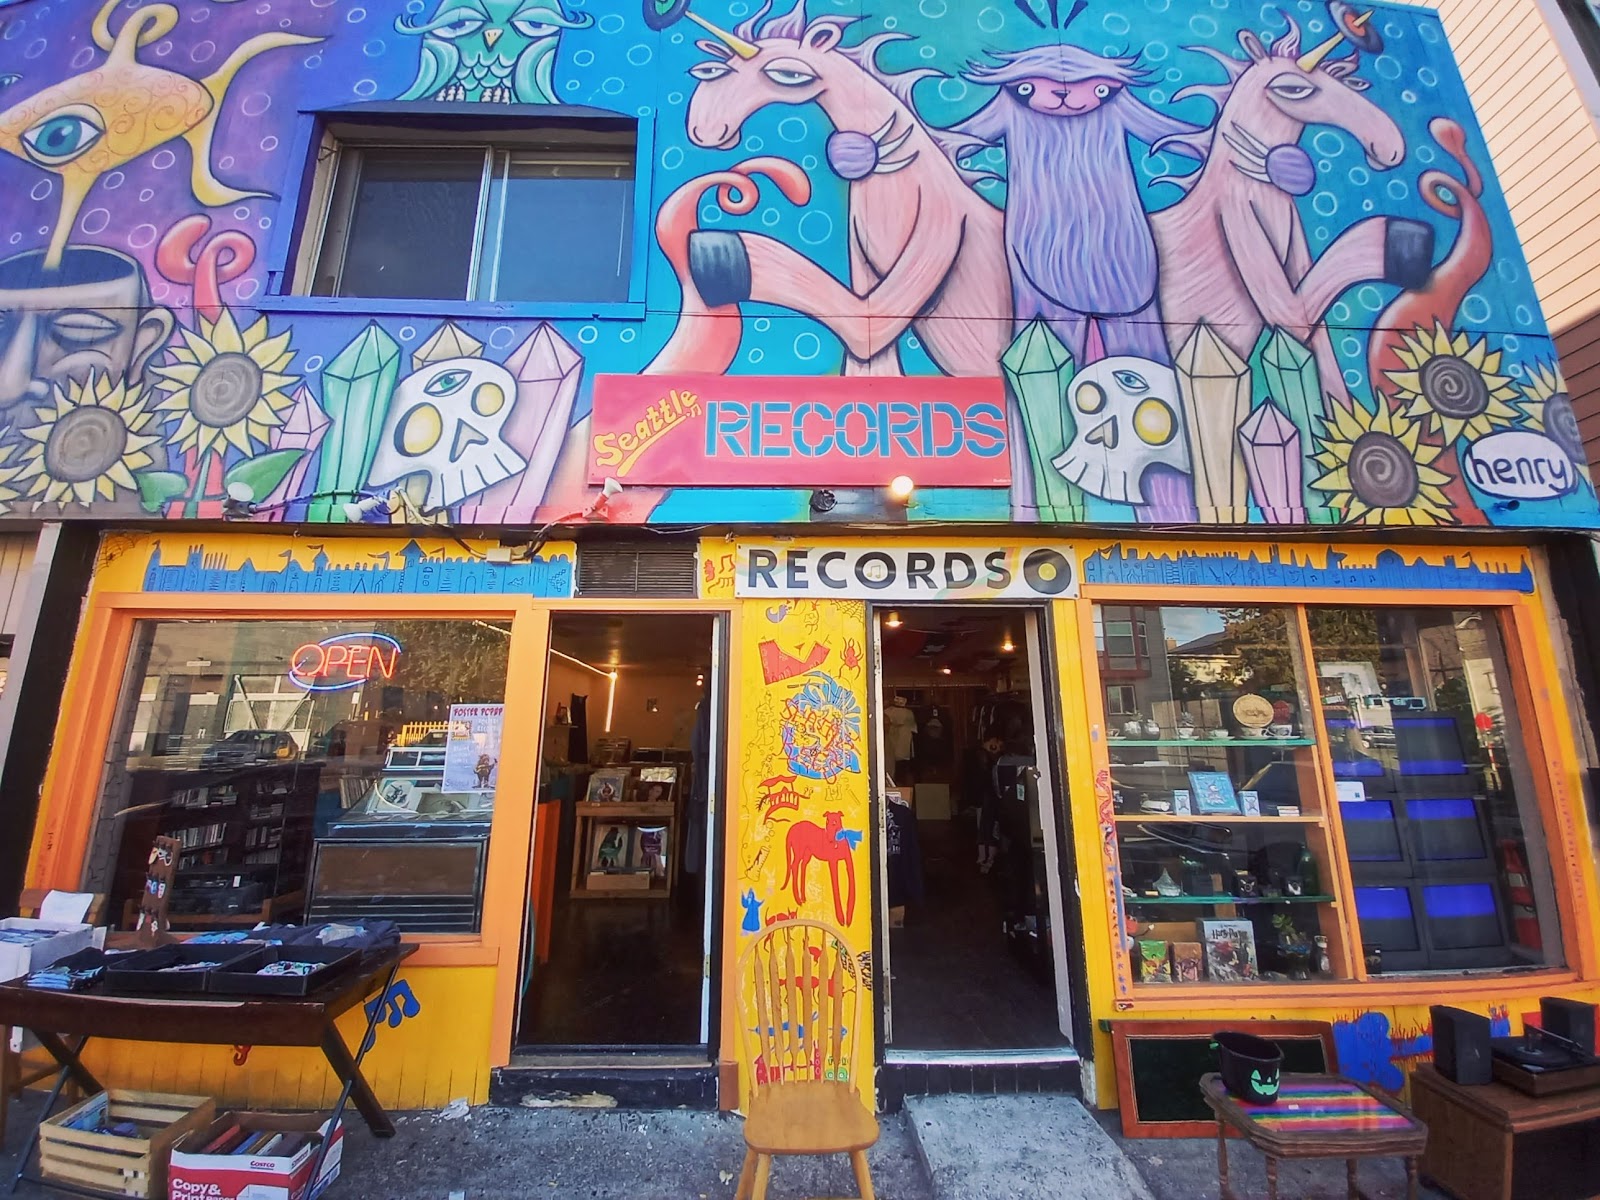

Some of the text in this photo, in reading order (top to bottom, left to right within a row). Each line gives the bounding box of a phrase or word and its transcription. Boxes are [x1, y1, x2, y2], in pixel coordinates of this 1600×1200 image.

[593, 389, 1006, 467] Seattle RECORDS
[1469, 446, 1569, 494] henry
[747, 549, 1011, 590] RECORDS
[291, 644, 397, 678] OPEN
